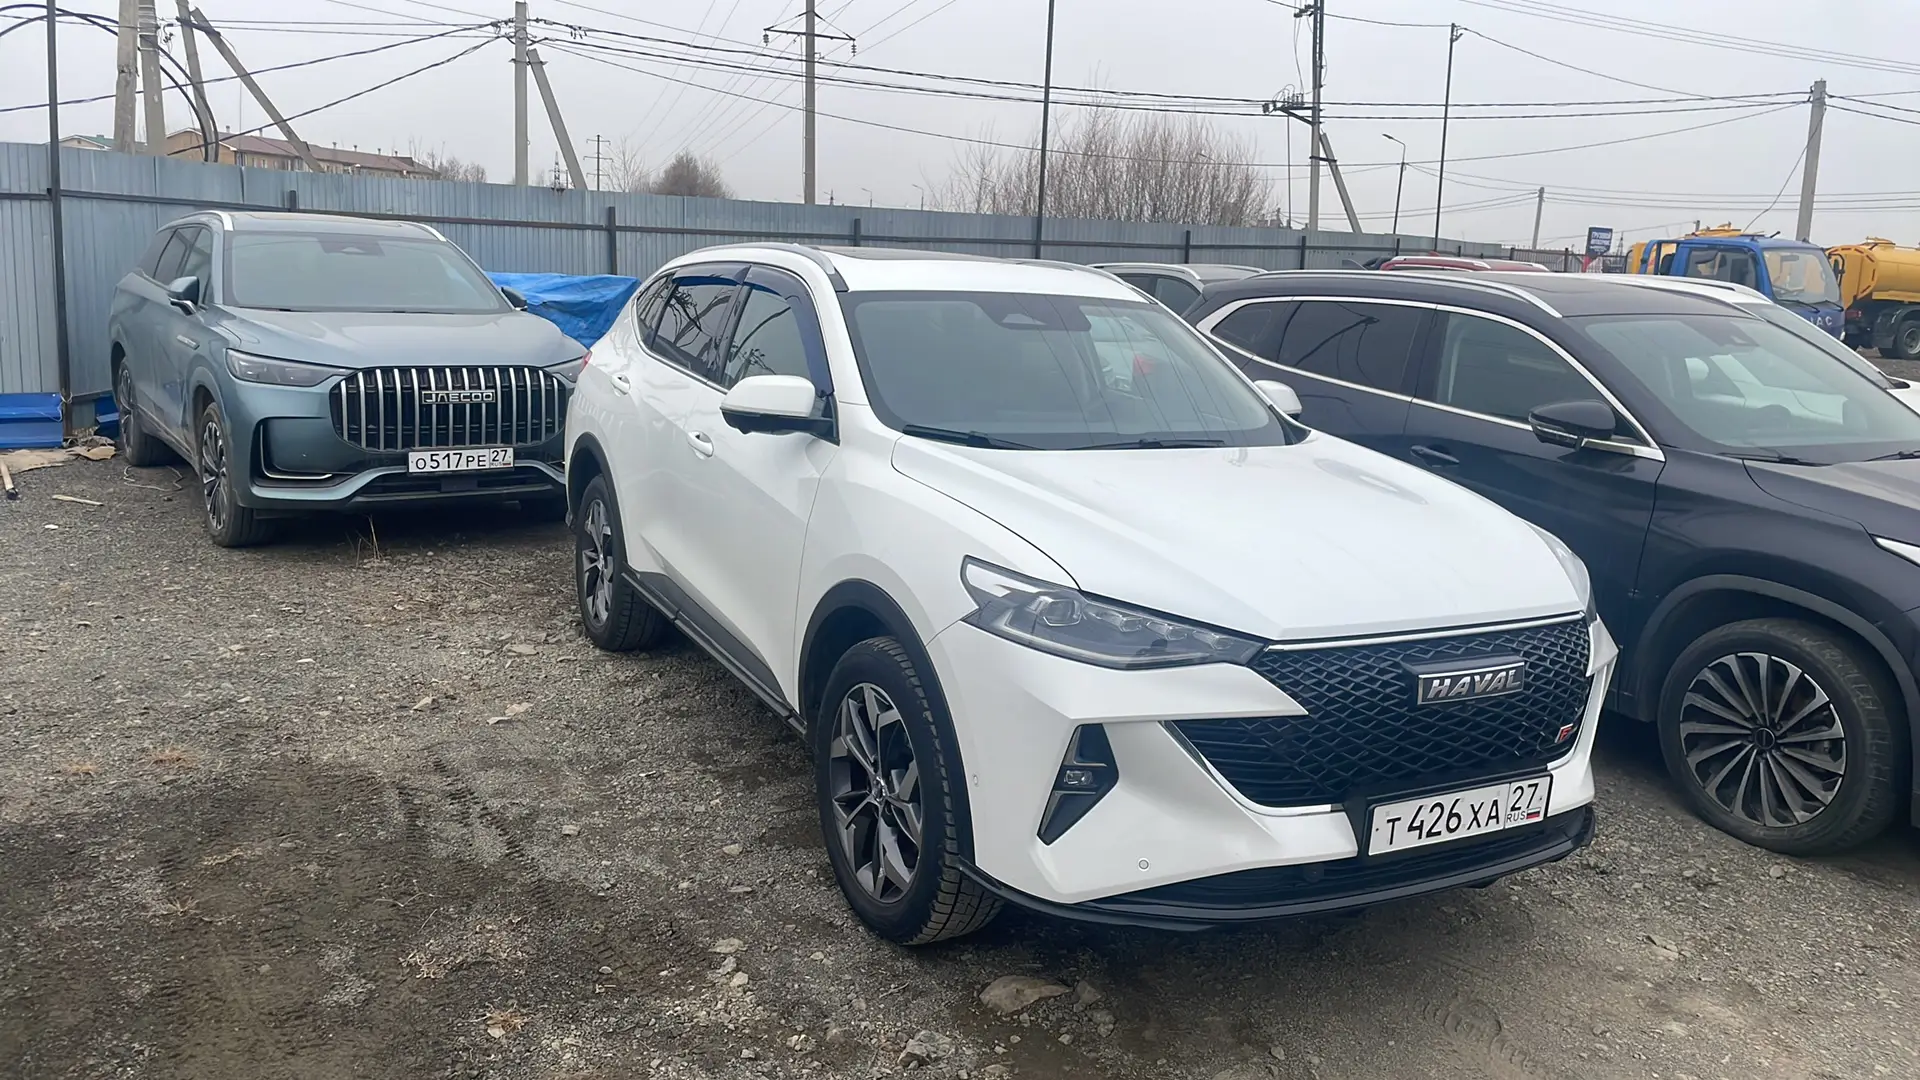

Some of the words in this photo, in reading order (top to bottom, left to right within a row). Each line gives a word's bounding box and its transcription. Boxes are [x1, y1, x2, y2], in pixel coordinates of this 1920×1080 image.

[491, 449, 508, 462] 27
[1426, 669, 1522, 699] HAVAL
[1510, 783, 1539, 812] 27
[1506, 810, 1526, 823] RUS
